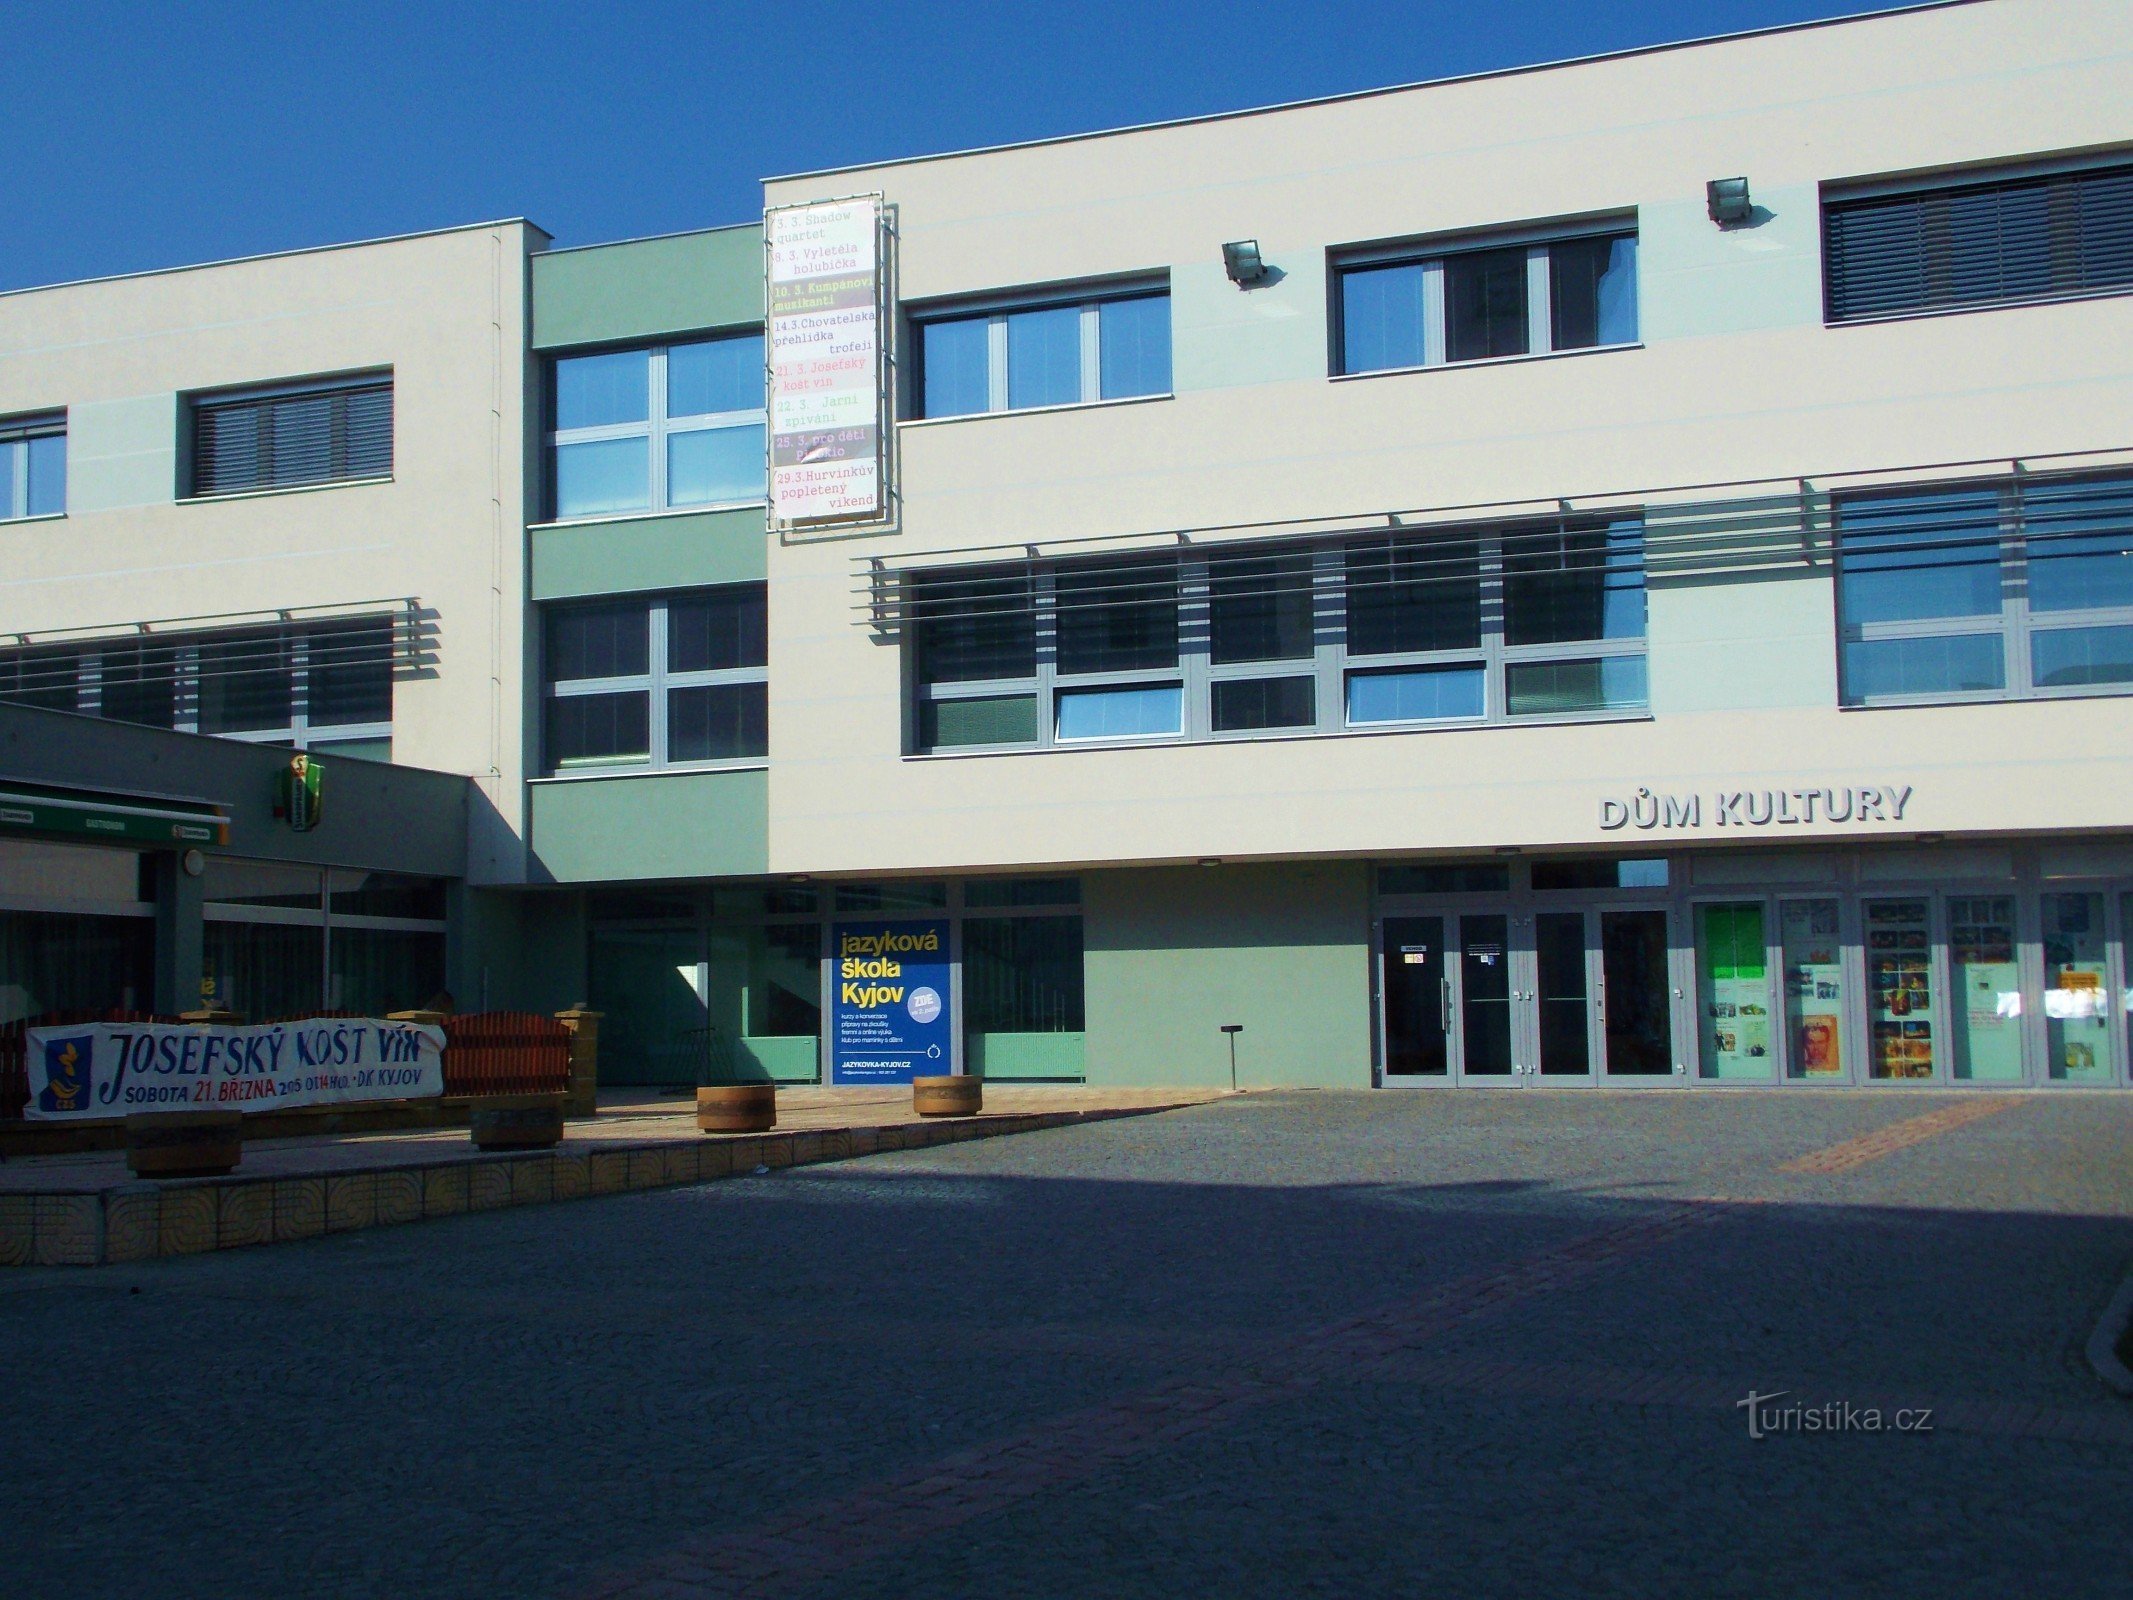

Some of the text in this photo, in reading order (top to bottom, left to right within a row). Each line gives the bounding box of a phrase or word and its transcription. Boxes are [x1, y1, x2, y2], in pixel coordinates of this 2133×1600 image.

[805, 211, 851, 226] Shadow
[777, 228, 826, 244] quartet
[1599, 784, 1914, 830] DŮM KULTURY
[840, 929, 938, 957] jazyková
[841, 957, 901, 979] škola
[841, 981, 905, 1009] Kyjov
[100, 1028, 286, 1104] JOSEFSKÝ
[297, 1024, 367, 1066] KOŠT
[124, 1086, 188, 1104] SOBOTA
[193, 1080, 215, 1102] 21.
[218, 1078, 277, 1102] BŘEZNA
[357, 1070, 374, 1087] DK
[378, 1069, 423, 1087] KYJOV
